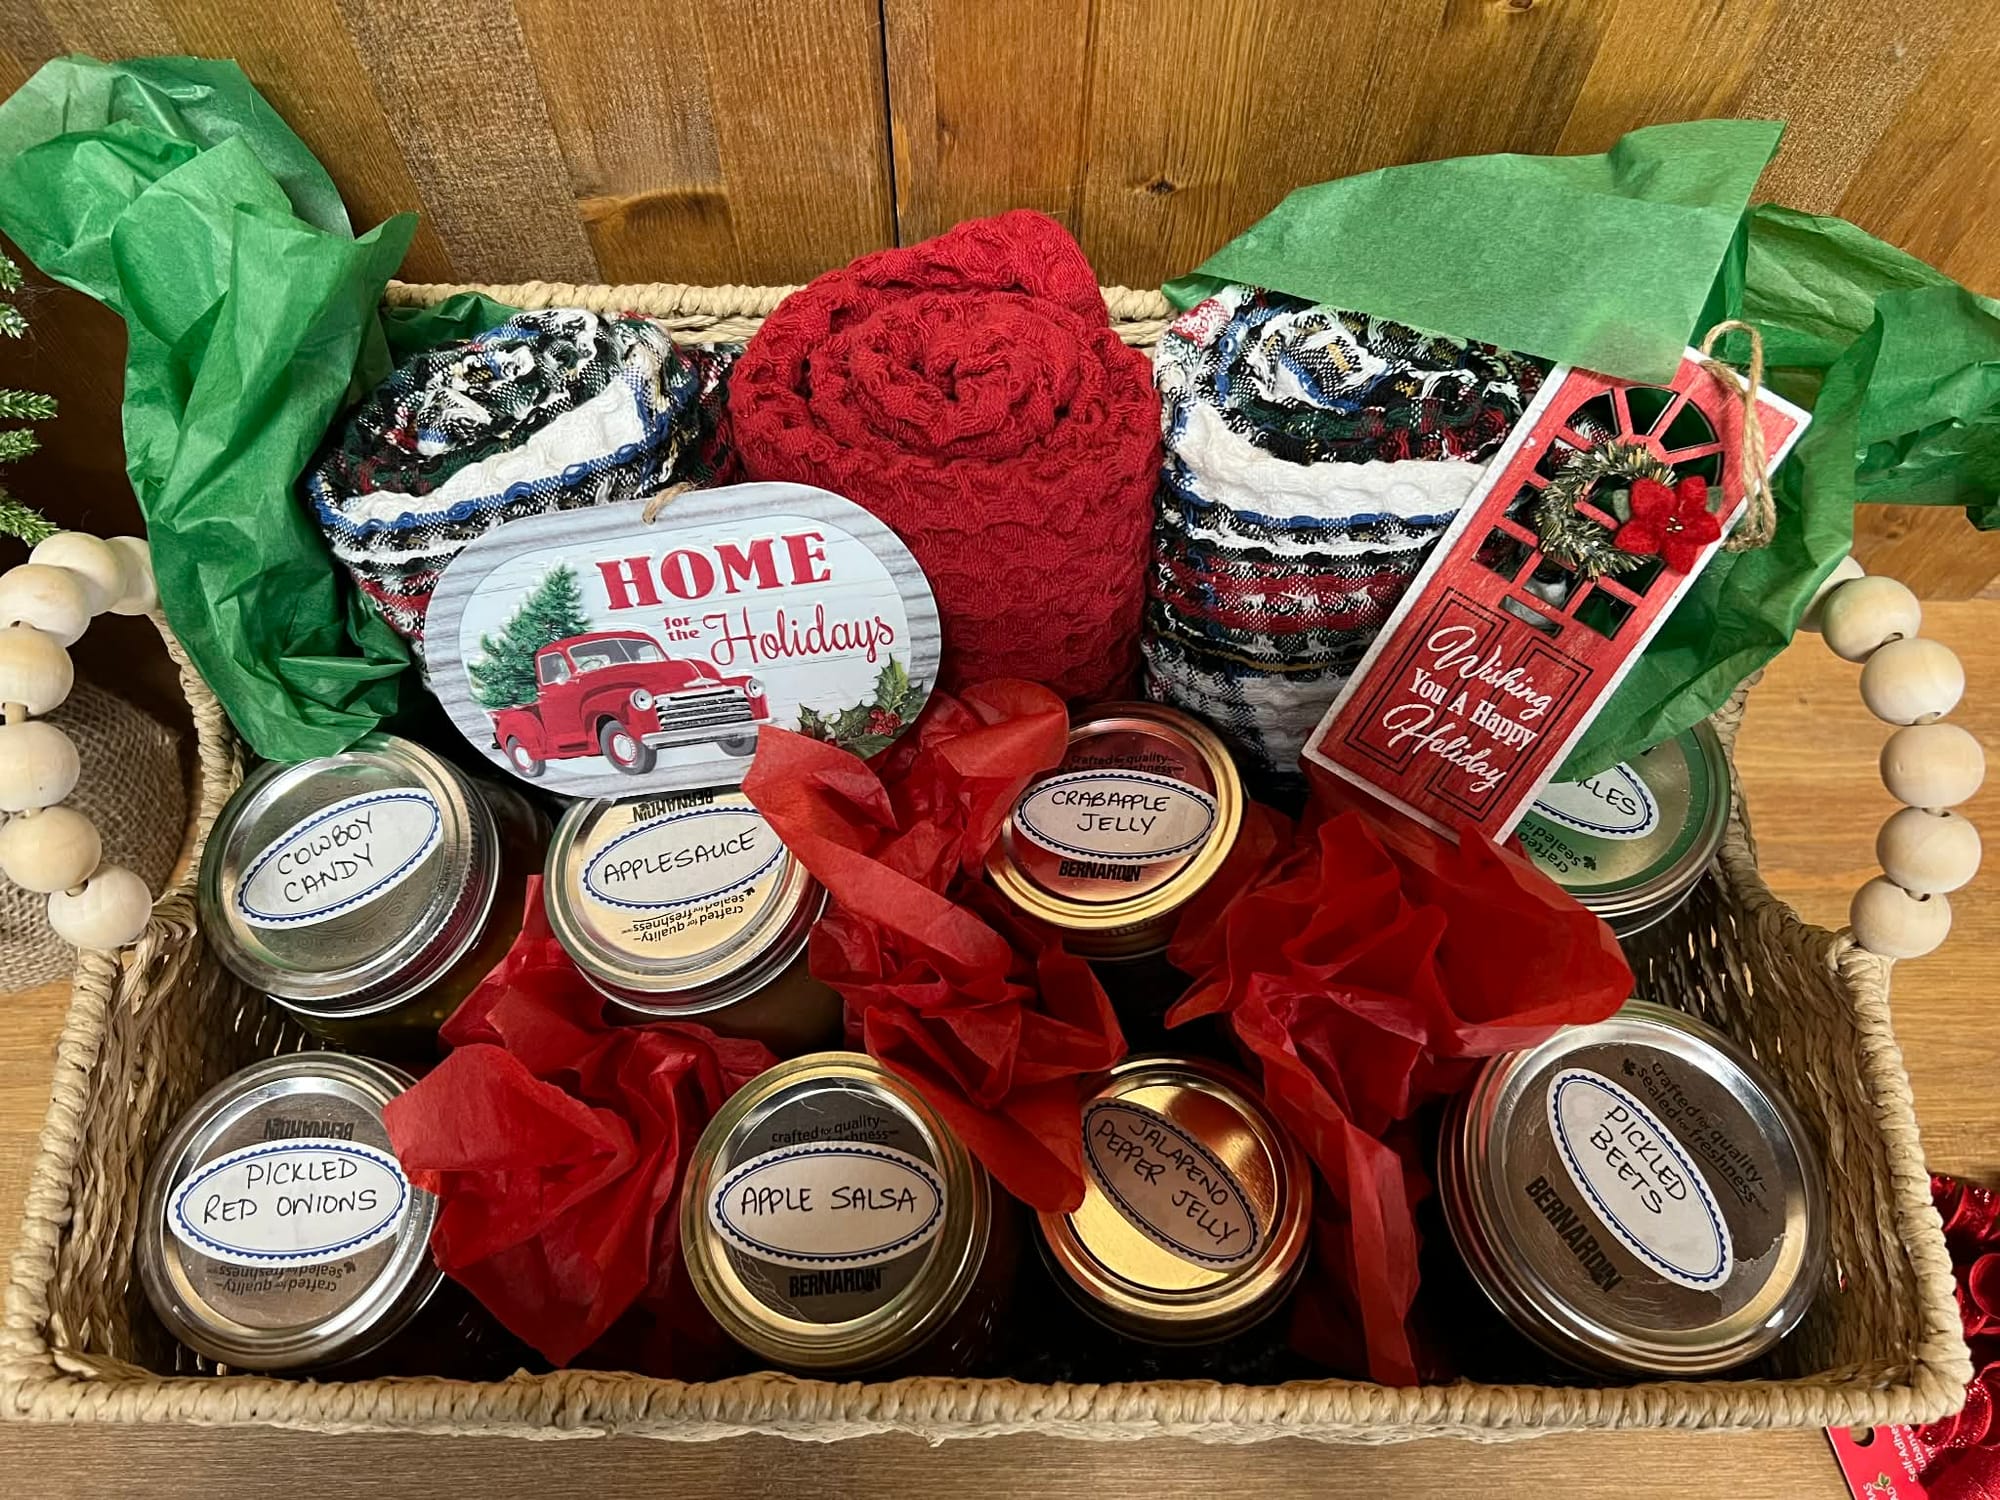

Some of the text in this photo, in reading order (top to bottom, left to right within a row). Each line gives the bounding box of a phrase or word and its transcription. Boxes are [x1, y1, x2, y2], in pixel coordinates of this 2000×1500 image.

[595, 531, 832, 610] HOME
[664, 616, 692, 631] for
[666, 627, 701, 642] the
[702, 603, 894, 666] Holidays
[1427, 625, 1553, 720] Wishing
[1408, 667, 1539, 752] You A Happy
[1382, 704, 1508, 793] Holiday
[1051, 789, 1171, 812] CRABAPPLE
[1076, 812, 1157, 835] JELLY
[277, 810, 375, 876] COWBOY
[603, 826, 759, 885] APPLESAUCE
[1532, 830, 1581, 866] sealed
[283, 843, 375, 902] CANDY
[1058, 859, 1143, 882] BERNARDIN
[632, 909, 693, 932] freshness
[687, 918, 699, 927] for
[699, 905, 744, 926] crafted
[1651, 1061, 1700, 1117] crafted
[1695, 1114, 1712, 1130] for
[771, 1126, 819, 1144] crafted
[1604, 1105, 1688, 1201] PICKLED
[1637, 1066, 1757, 1204] sealed for freshness
[246, 1158, 358, 1189] PICKLED
[1095, 1119, 1240, 1245] PEPPER JELLY
[1128, 1119, 1229, 1206] JALAPENO
[1590, 1124, 1663, 1214] BEETS
[203, 1189, 378, 1224] RED ONIONS
[740, 1186, 918, 1217] APPLE SALSA
[1525, 1175, 1624, 1293] BERNARDIN
[287, 1278, 337, 1292] crafted
[789, 1268, 882, 1298] BERNARDIN
